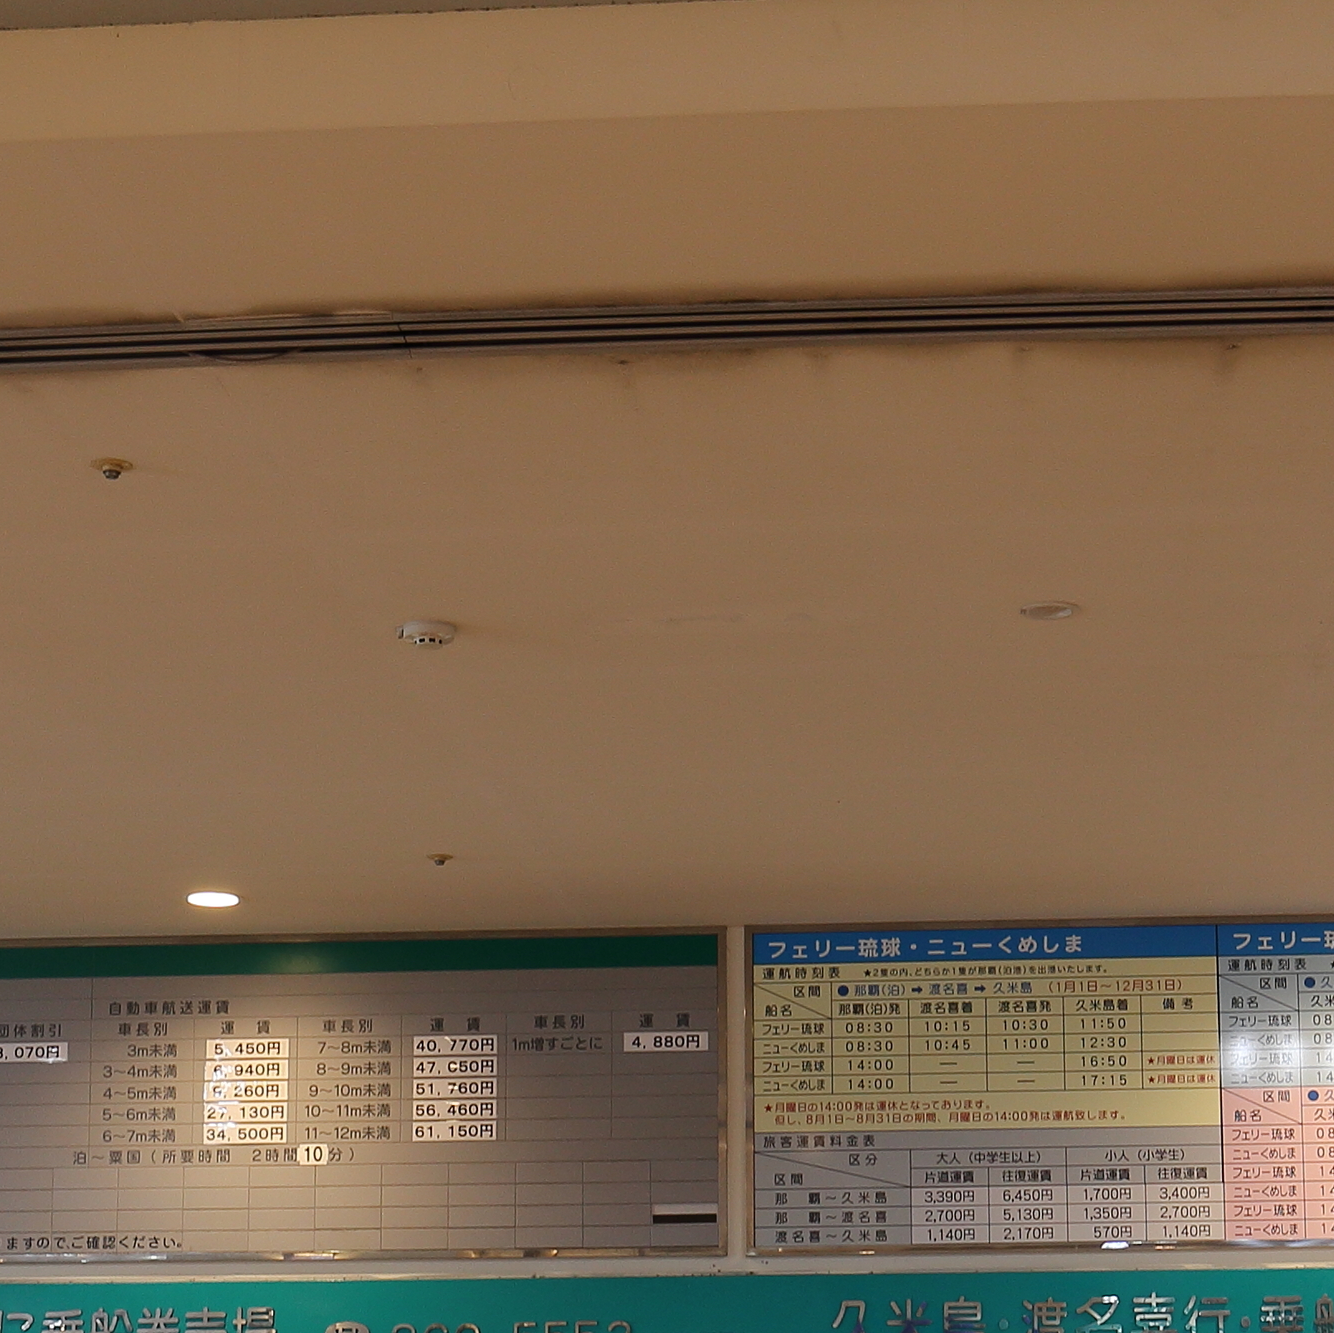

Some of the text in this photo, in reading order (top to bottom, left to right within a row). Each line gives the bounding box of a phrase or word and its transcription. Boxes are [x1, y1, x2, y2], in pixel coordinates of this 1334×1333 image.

[767, 934, 1084, 960] フェリー琉球・ニューくめしま
[762, 966, 841, 980] 運航時刻表
[1227, 958, 1308, 972] 運航時刻表
[793, 985, 821, 998] 区間
[928, 981, 1033, 997] 渡名喜 久米島
[109, 1000, 230, 1016] 自動車航送運賃
[1075, 998, 1128, 1013] 久米島着
[118, 1022, 168, 1037] 車長別
[322, 1018, 373, 1033] 車長別
[761, 1018, 1127, 1036] フェリー琉球 08:30 10:15 10:30 11:50
[631, 1033, 701, 1050] 4,880円
[763, 1036, 1127, 1055] ニューくめしま 08:30 10:45 11:00 12:30
[127, 1042, 281, 1058] 3m未満 5,450円
[1081, 1054, 1128, 1067] 16:50
[206, 1126, 284, 1142] 34,500円
[415, 1124, 494, 1139] 61,150円
[763, 1134, 876, 1148] 旅客運賃料金表
[924, 1185, 1211, 1204] 3,390円 6,450円 1,700円 3,400円
[924, 1204, 1211, 1223] 2,700円 5,130円 1,350円 2,700円
[926, 1223, 1211, 1242] 1,140円 2,170円 570円 1,140円
